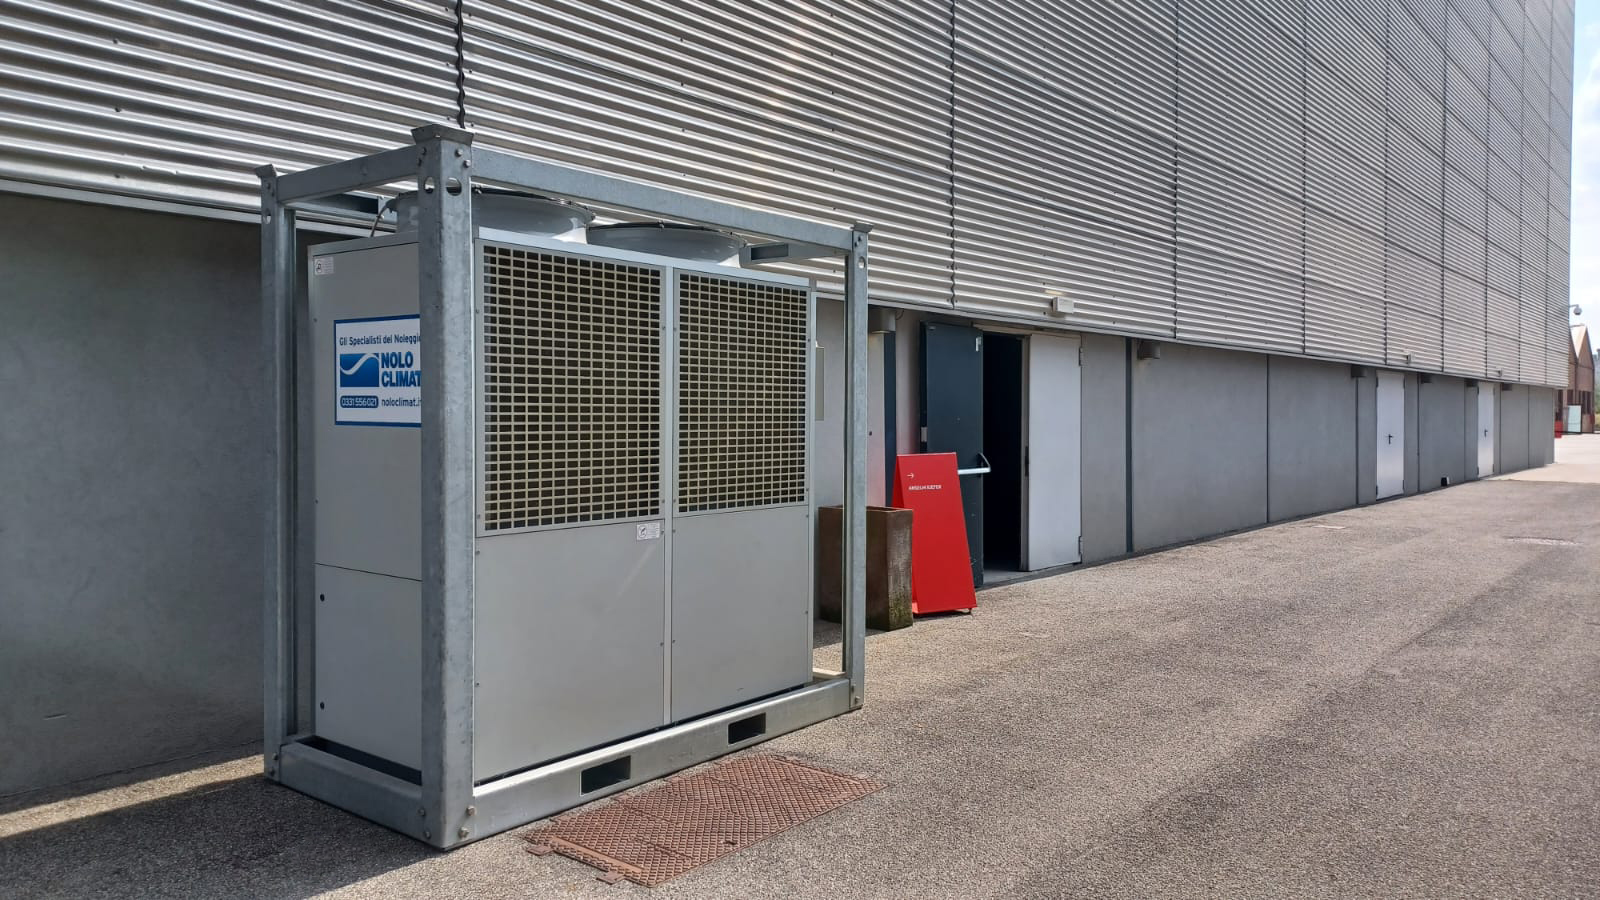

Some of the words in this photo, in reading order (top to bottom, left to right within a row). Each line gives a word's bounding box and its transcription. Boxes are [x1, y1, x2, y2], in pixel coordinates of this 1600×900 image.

[339, 336, 348, 346] Gli
[349, 335, 382, 346] Specialisti
[381, 351, 414, 368] NOLO
[381, 370, 422, 387] CLIMAT
